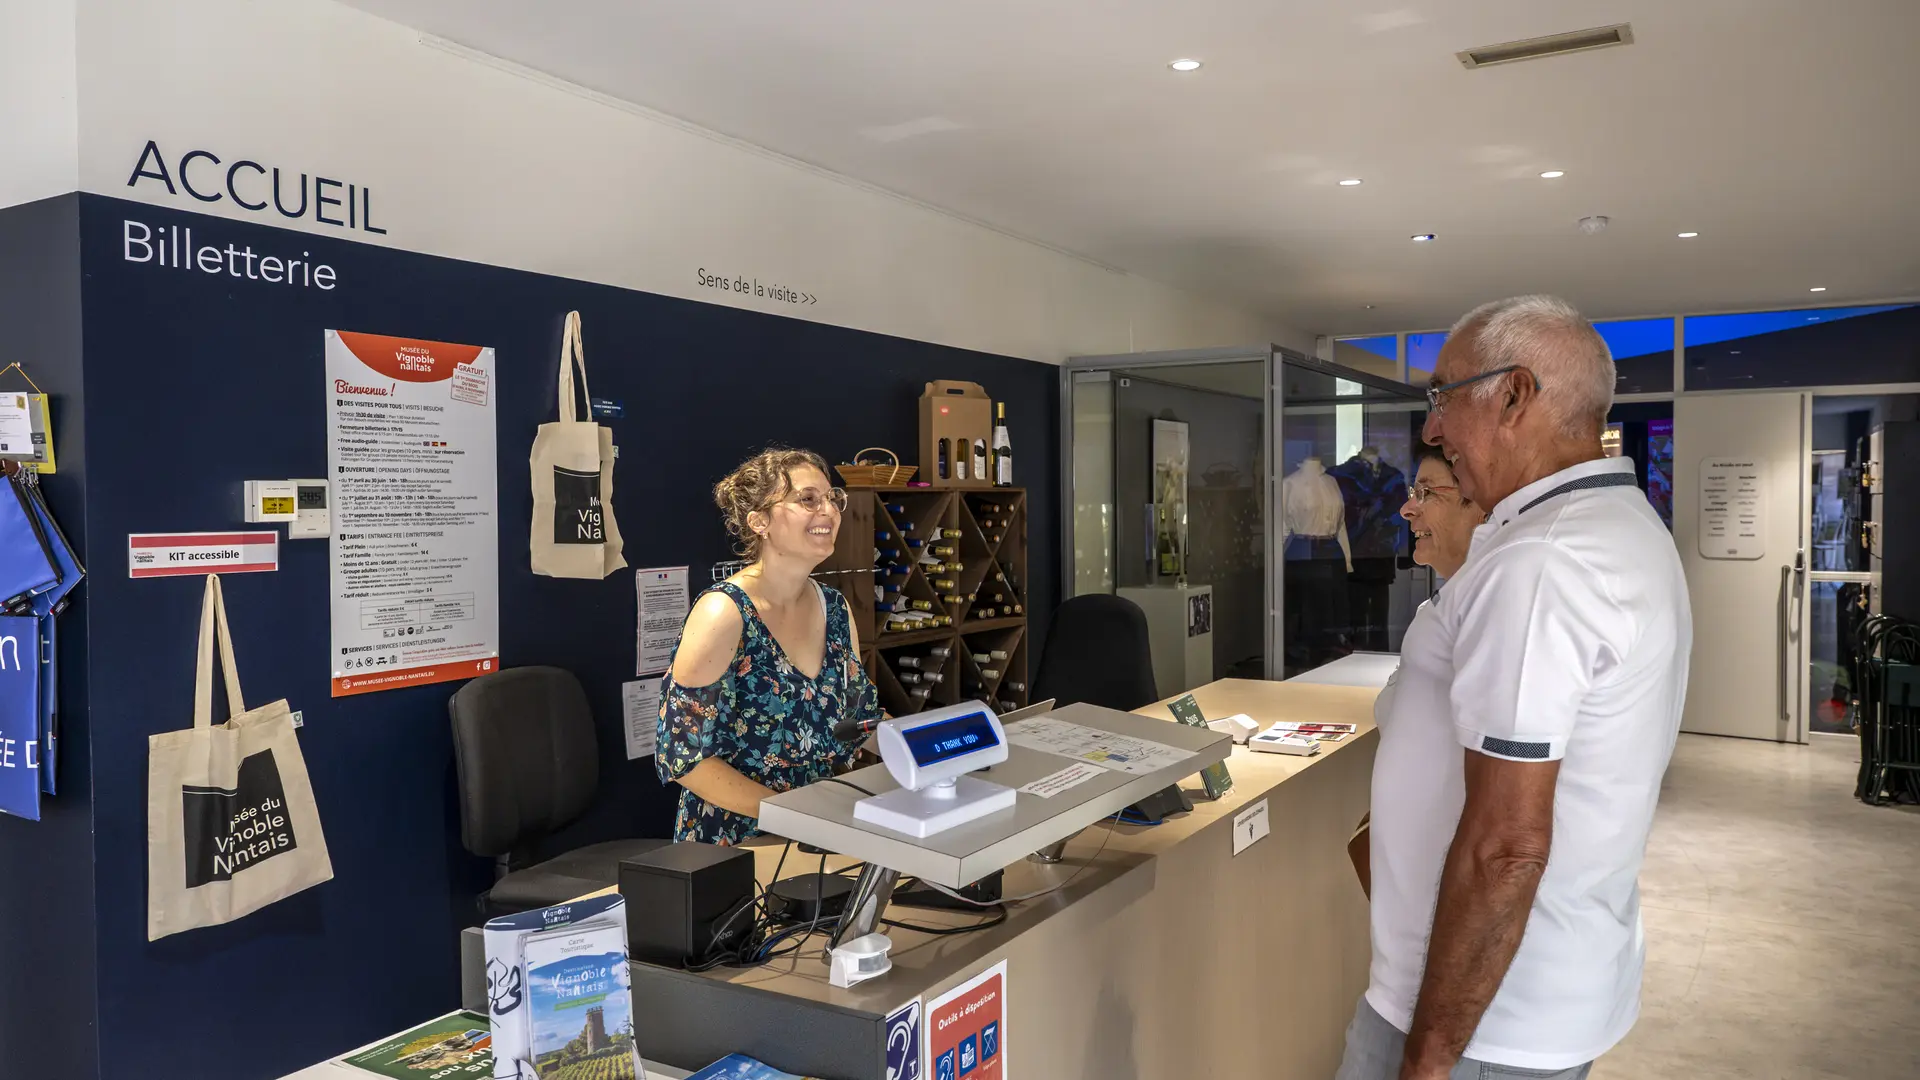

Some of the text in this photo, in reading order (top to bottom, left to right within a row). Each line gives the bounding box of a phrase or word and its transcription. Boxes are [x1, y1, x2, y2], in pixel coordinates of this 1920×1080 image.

[127, 140, 387, 235] ACCUEIL
[124, 219, 337, 290] Billetterie
[698, 267, 729, 290] Sens
[733, 275, 750, 294] de
[754, 278, 764, 297] la
[767, 284, 798, 304] visite
[400, 346, 420, 354] MUSÉE
[396, 352, 435, 364] Vignoble
[458, 364, 485, 376] GRATUIT
[334, 380, 388, 396] Bienvenue
[169, 550, 240, 561] KIT accessible
[401, 638, 446, 647] DIENSTLEISTUNGEN
[353, 671, 435, 687] WWW.MUSEE-VIGNOBLE-NANTAIS.EU
[942, 738, 962, 750] THANK
[261, 797, 281, 812] du
[215, 814, 284, 853] Vinoble
[214, 832, 289, 874] Nntais
[542, 907, 571, 919] Vignoble
[545, 914, 570, 924] Nantais
[560, 943, 594, 953] Touristique
[552, 968, 606, 988] Vignoble
[556, 982, 604, 999] Nantais
[938, 990, 996, 1030] Outils à disposition
